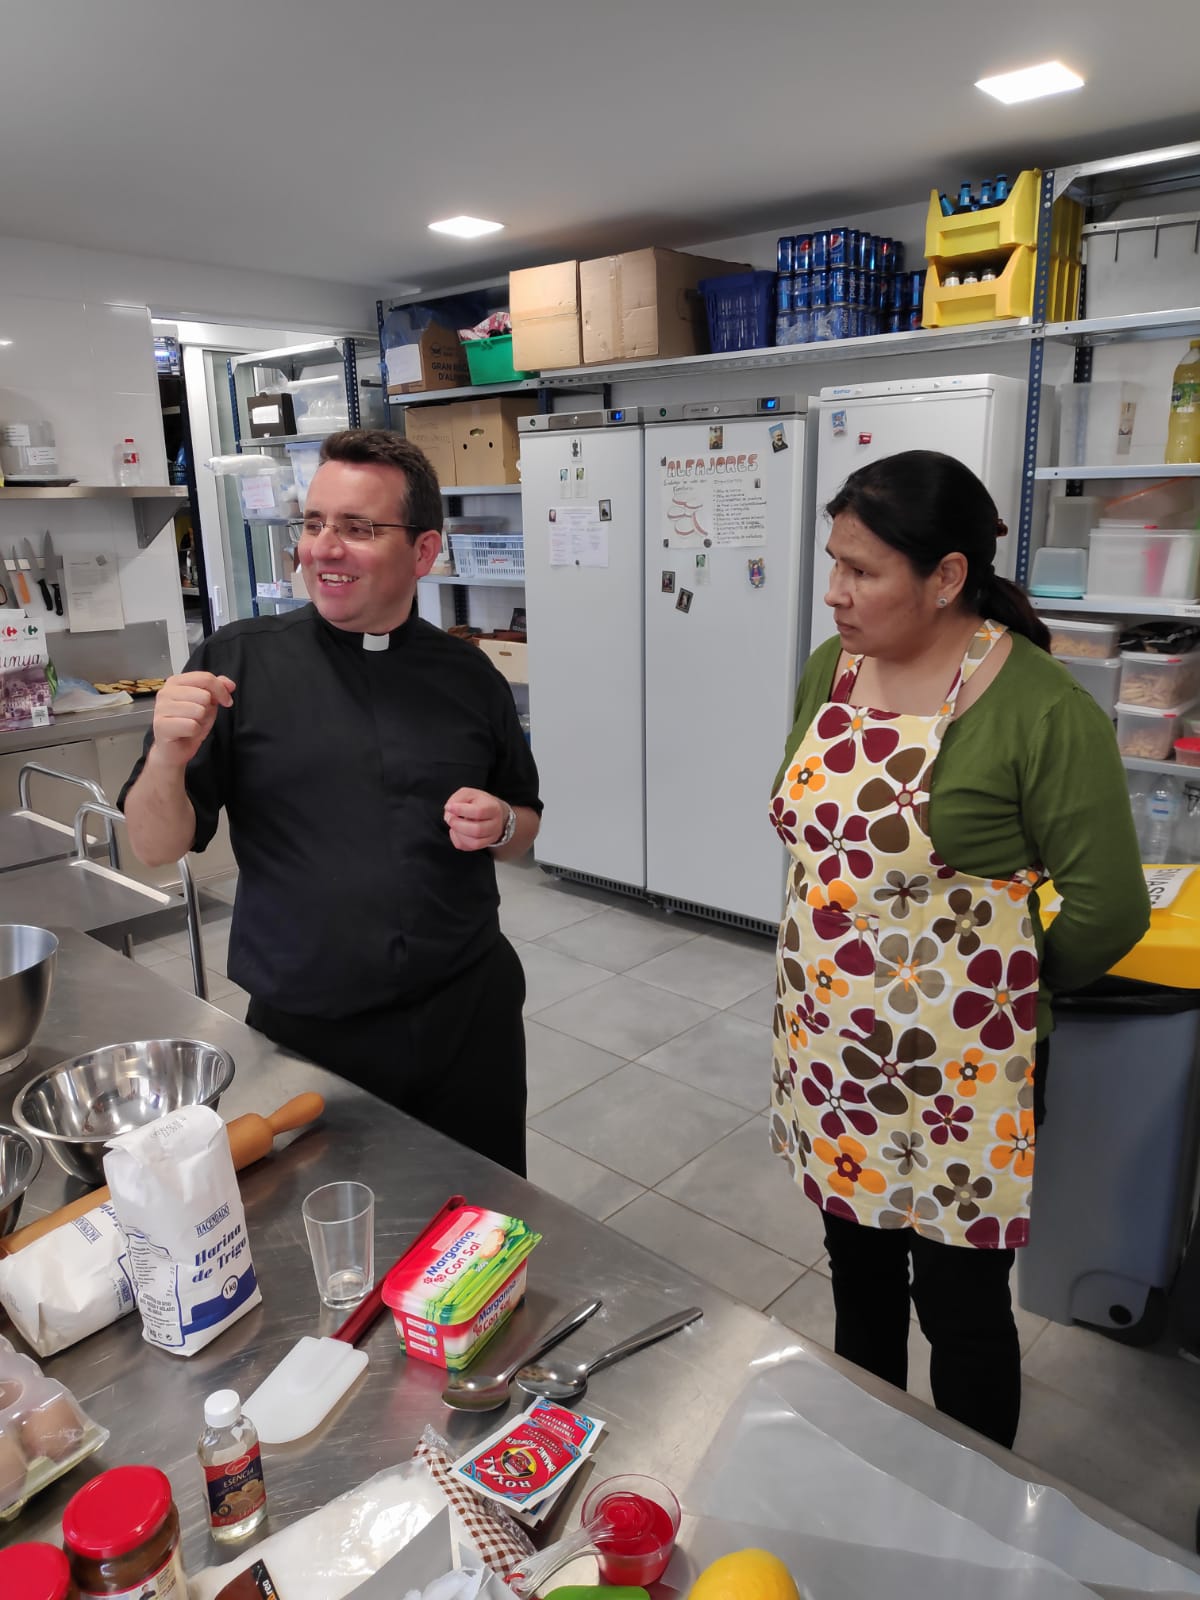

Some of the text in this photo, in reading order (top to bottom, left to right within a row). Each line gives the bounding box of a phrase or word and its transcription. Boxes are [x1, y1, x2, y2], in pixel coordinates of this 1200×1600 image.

[667, 453, 759, 478] ALFAJORES
[196, 1205, 230, 1235] HACENDADO
[192, 1237, 247, 1284] de Trigo
[194, 1224, 242, 1267] Harina
[445, 1241, 481, 1276] Con Sal
[484, 1311, 498, 1330] Con
[483, 1455, 531, 1488] ROYAL
[536, 1446, 557, 1472] BAKING
[223, 1467, 254, 1488] ESENCIA
